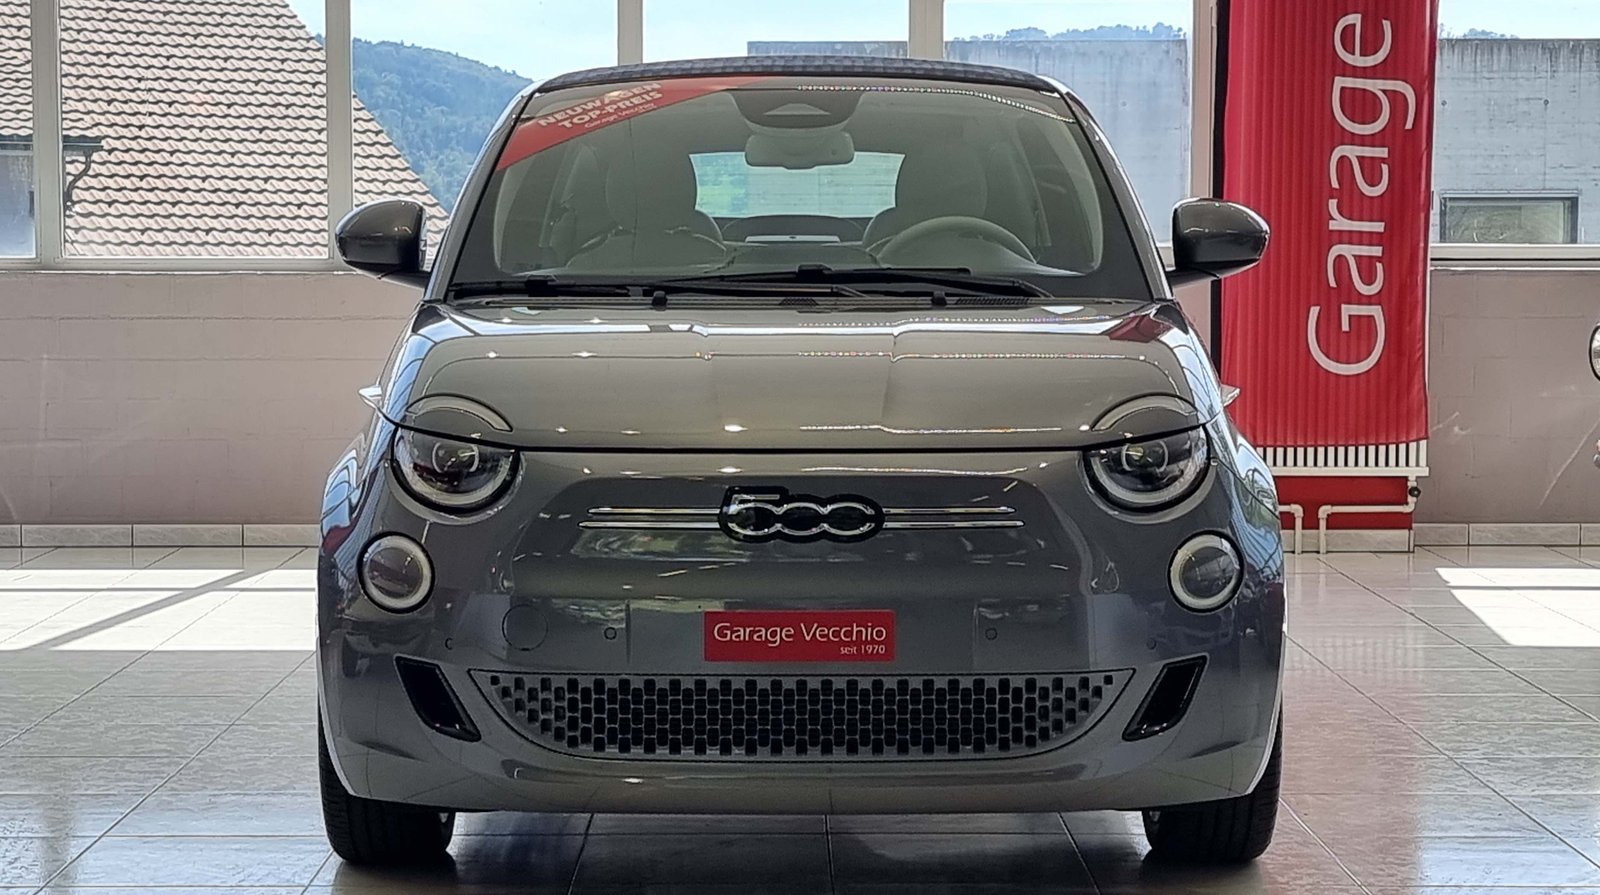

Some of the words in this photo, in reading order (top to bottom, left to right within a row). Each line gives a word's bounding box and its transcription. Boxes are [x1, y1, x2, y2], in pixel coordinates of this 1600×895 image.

[537, 83, 662, 127] NEUWAGEN
[558, 91, 663, 128] TOP-PREIS
[1307, 13, 1416, 376] Garage
[719, 486, 885, 543] 500
[713, 622, 795, 647] Garage
[800, 622, 887, 642] Vecchio
[840, 645, 857, 655] seit
[861, 644, 886, 654] 1970
